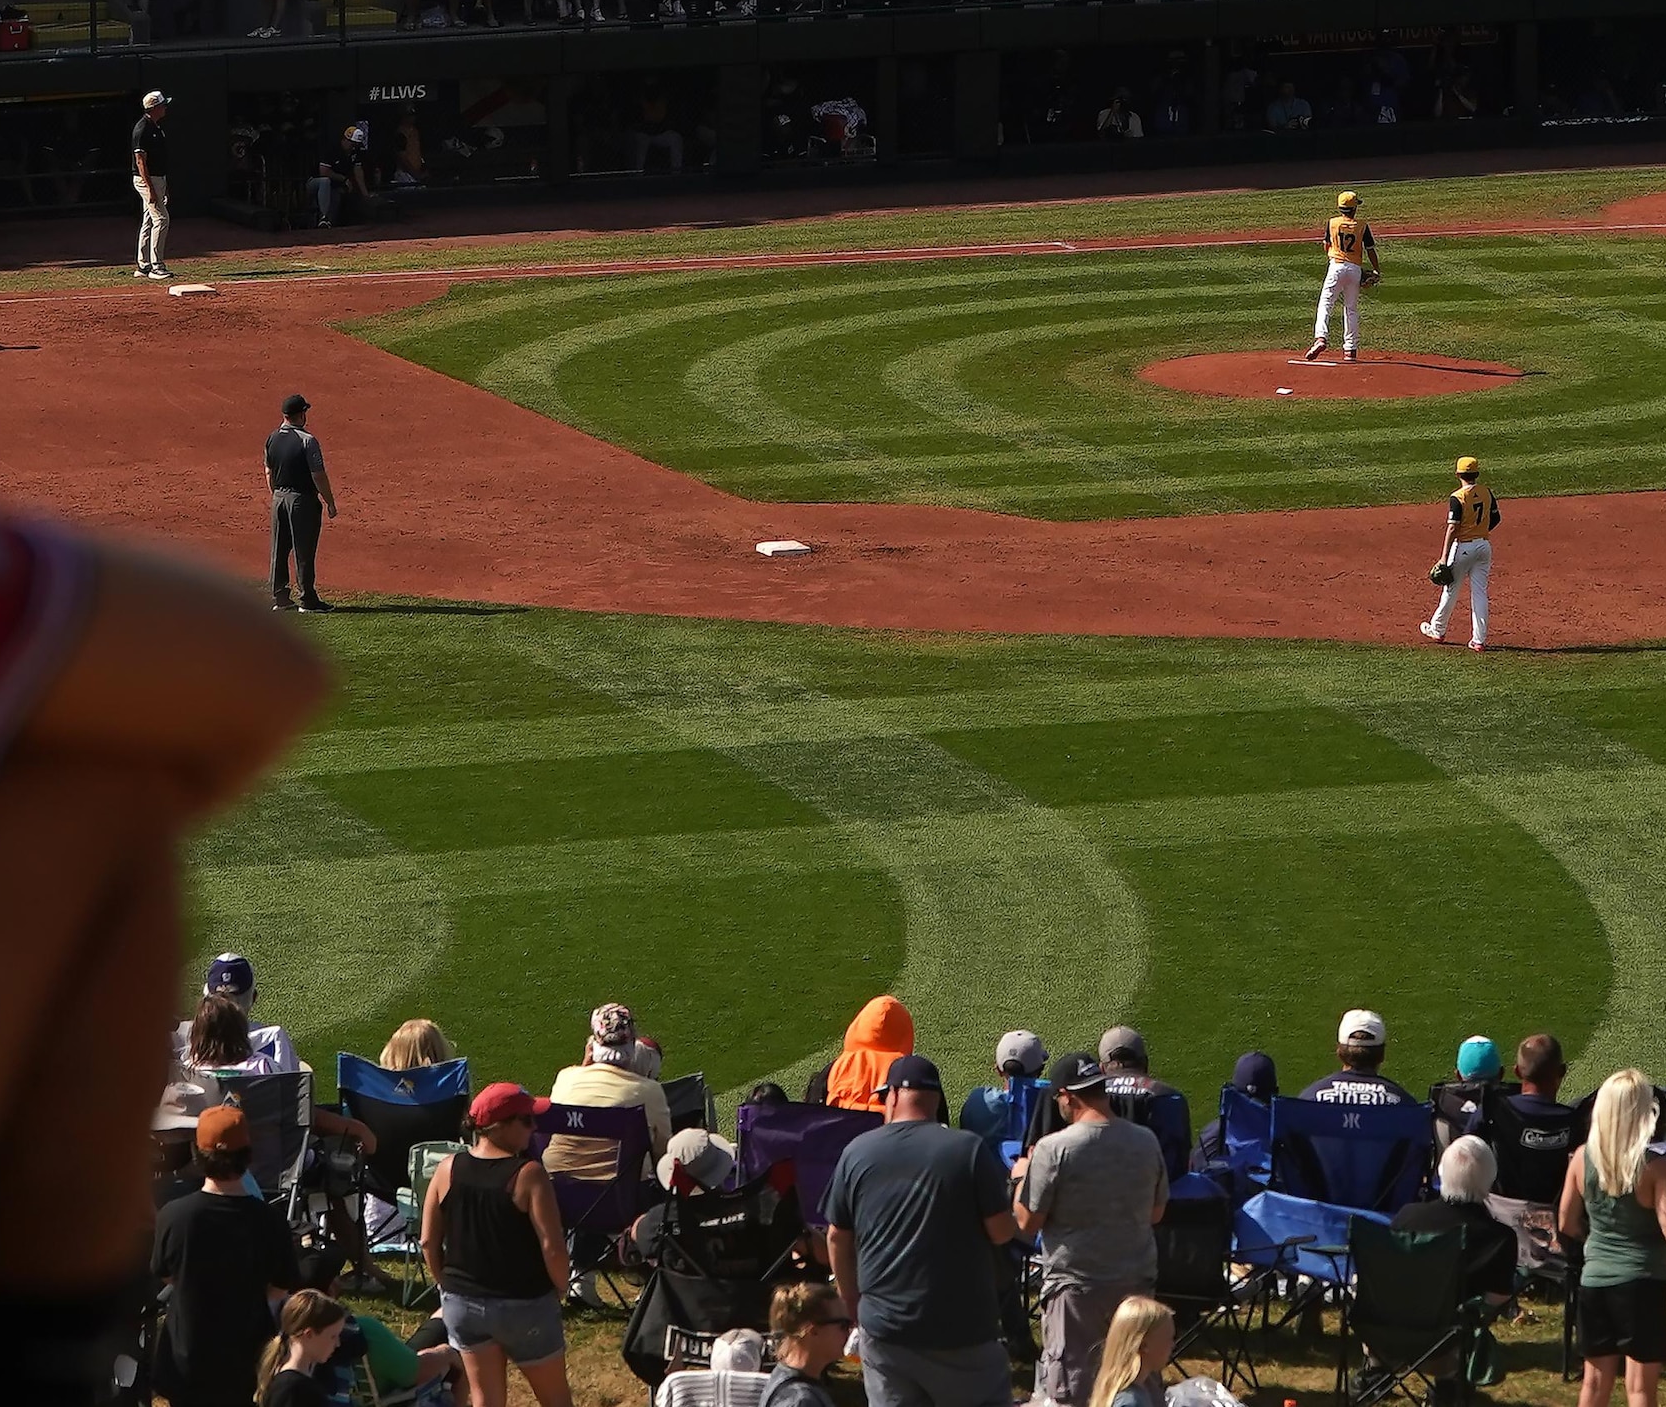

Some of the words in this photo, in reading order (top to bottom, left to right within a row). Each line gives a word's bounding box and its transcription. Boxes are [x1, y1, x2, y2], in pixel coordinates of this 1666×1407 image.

[369, 84, 427, 100] #LLWS
[1338, 233, 1356, 252] 12
[1473, 502, 1483, 525] 7
[1332, 1080, 1387, 1093] TACOMA
